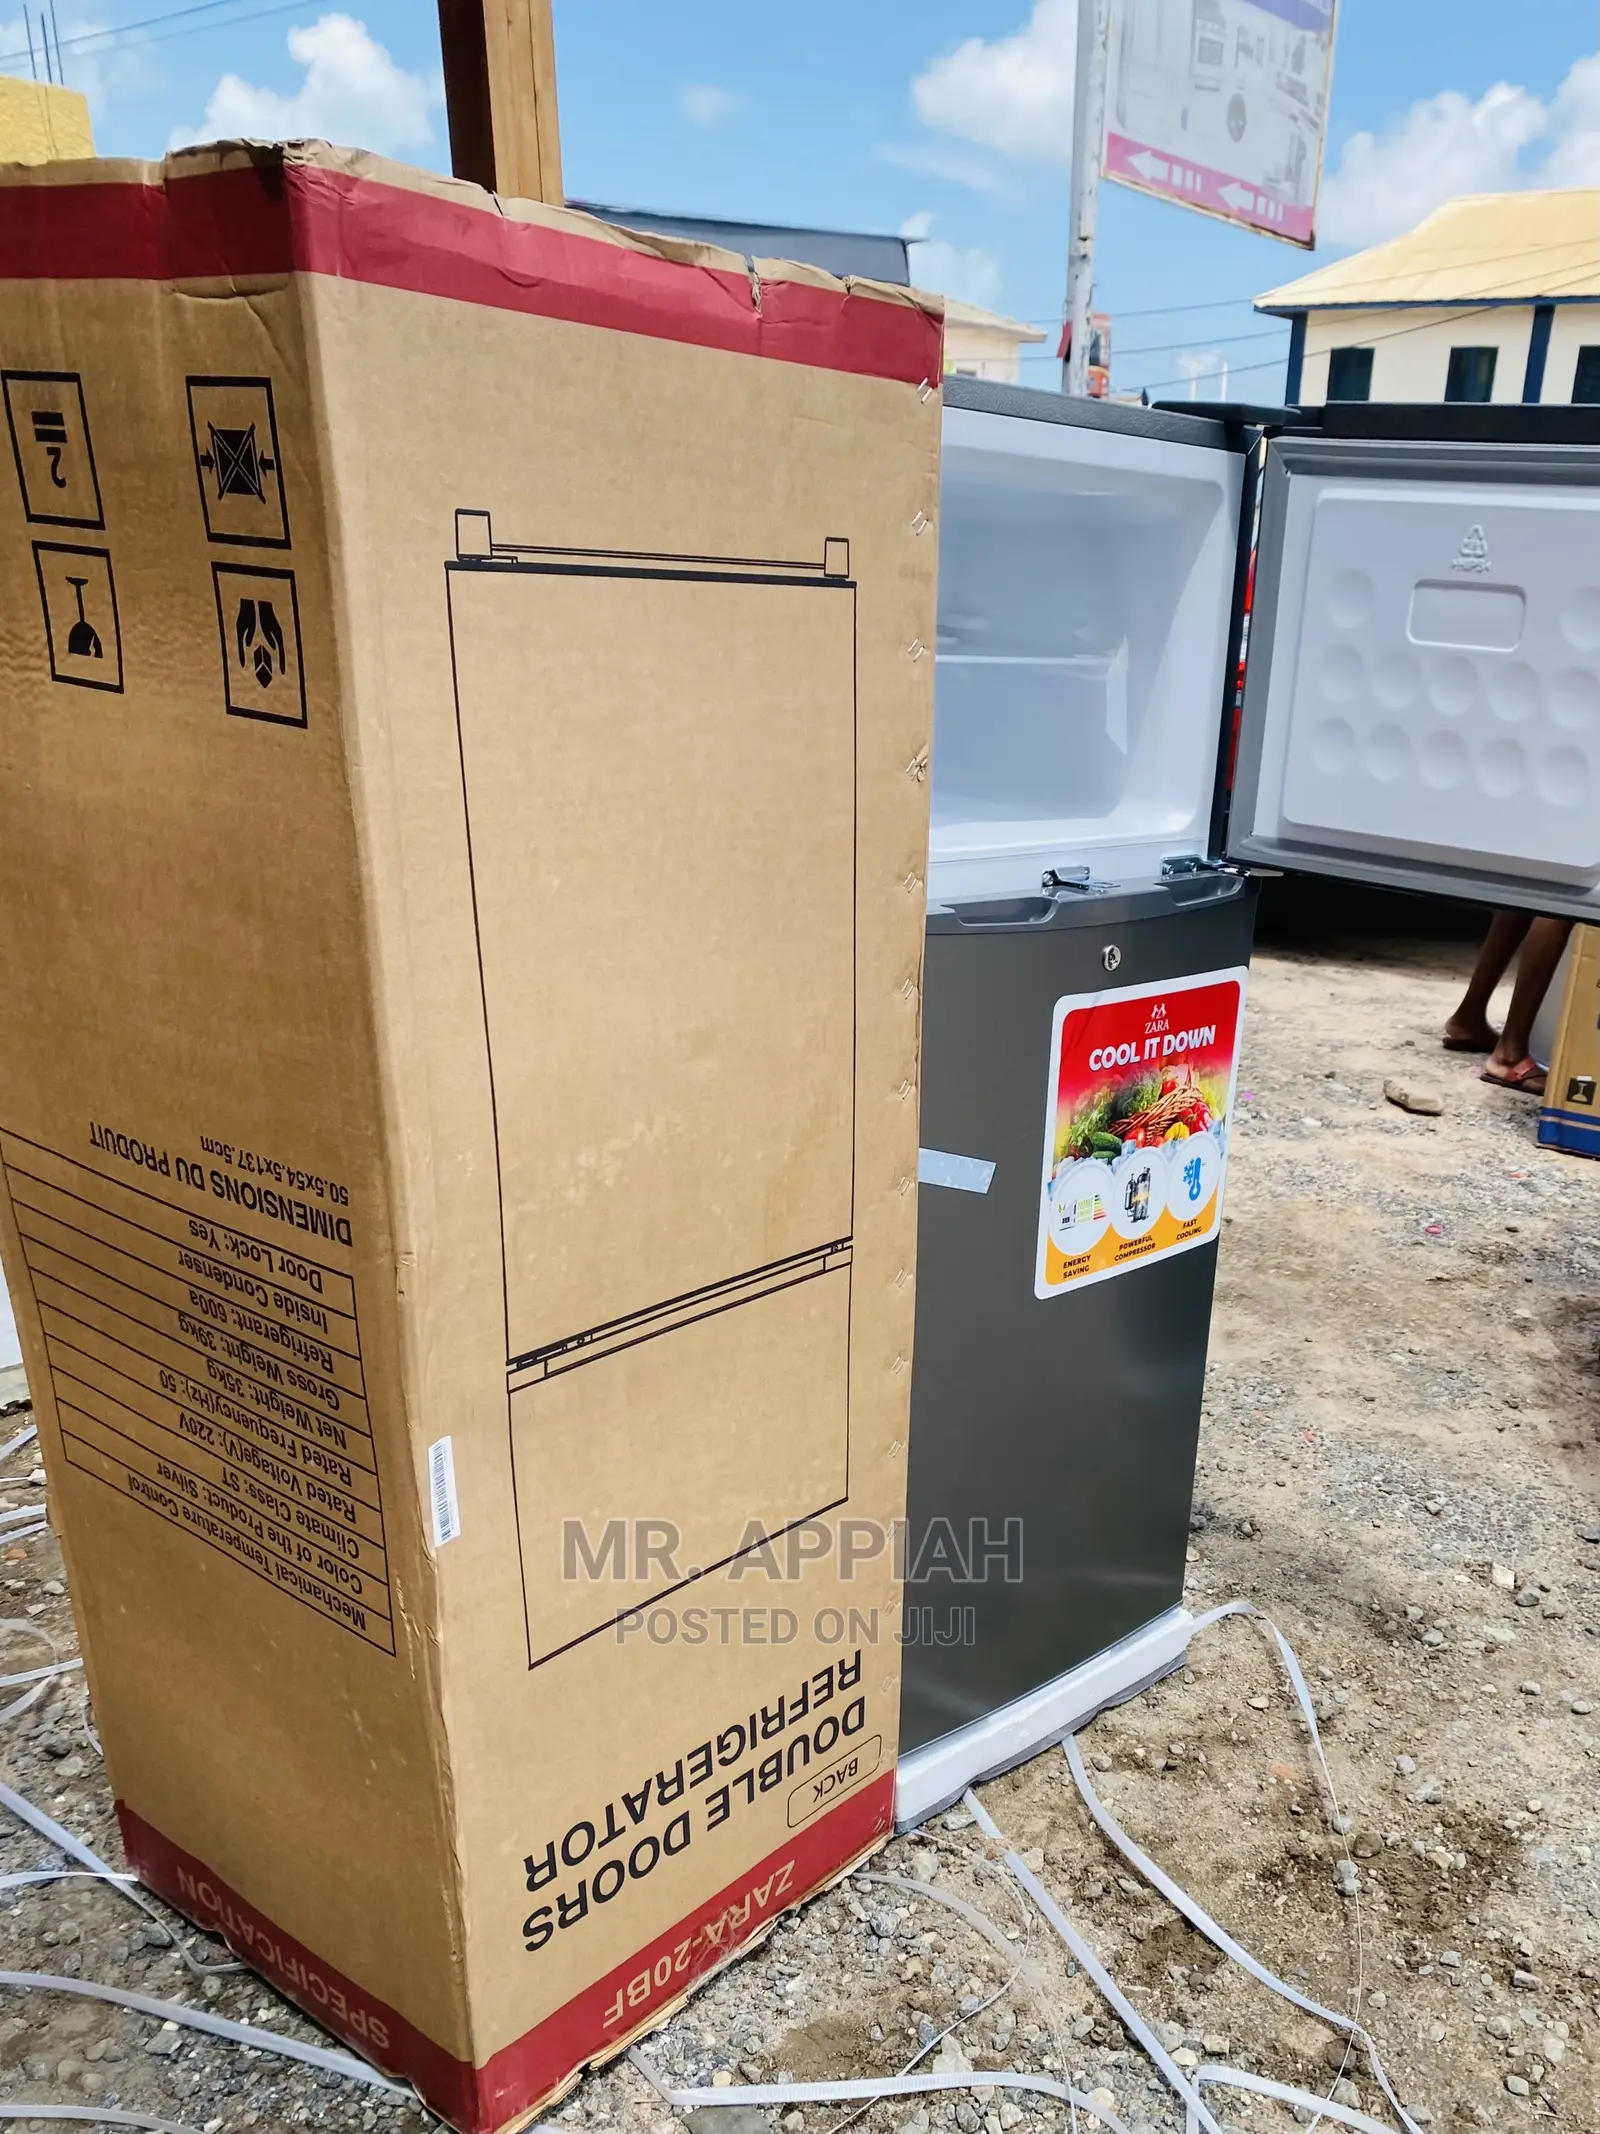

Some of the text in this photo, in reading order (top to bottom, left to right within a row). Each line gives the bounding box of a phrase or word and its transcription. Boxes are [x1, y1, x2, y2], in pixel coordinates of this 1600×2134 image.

[1089, 1025, 1216, 1071] COOL IT DOWN
[1144, 1019, 1170, 1034] ZARA
[89, 1122, 353, 1247] DIMENSIONS DU PRODUIT
[199, 1135, 349, 1207] 50.5x54.5x137.5cm
[189, 1219, 323, 1294] Door Lock: Yes
[1063, 1255, 1091, 1269] ENERGY
[1114, 1243, 1156, 1261] COMPRESSOR
[1119, 1235, 1153, 1251] POWERFUL
[1176, 1226, 1202, 1241] COOLING
[1183, 1218, 1198, 1229] FAST
[177, 1250, 328, 1334] Inside Condenser
[1063, 1265, 1090, 1279] SAVING
[177, 1310, 340, 1411] Gross Weight: 39kg
[188, 1288, 334, 1374] Refrigerant: 600a
[160, 1369, 177, 1394] 50
[206, 1358, 348, 1450] Net Weight: 35kg
[179, 1411, 357, 1525] Rated Voltage(V): 220V
[303, 1445, 353, 1487] Rated
[157, 1462, 363, 1595] Color of the Product: Silver
[221, 1466, 360, 1559] Climate Class: ST
[127, 1473, 367, 1632] Mechanical Temperature Control
[523, 1649, 862, 1893] REFRIGERATOR
[812, 1757, 859, 1804] BACK
[522, 1696, 866, 1953] DOUBLE DOORS
[177, 1865, 390, 2049] SPECIFICATION
[603, 1859, 797, 2030] ZARA-20BF
